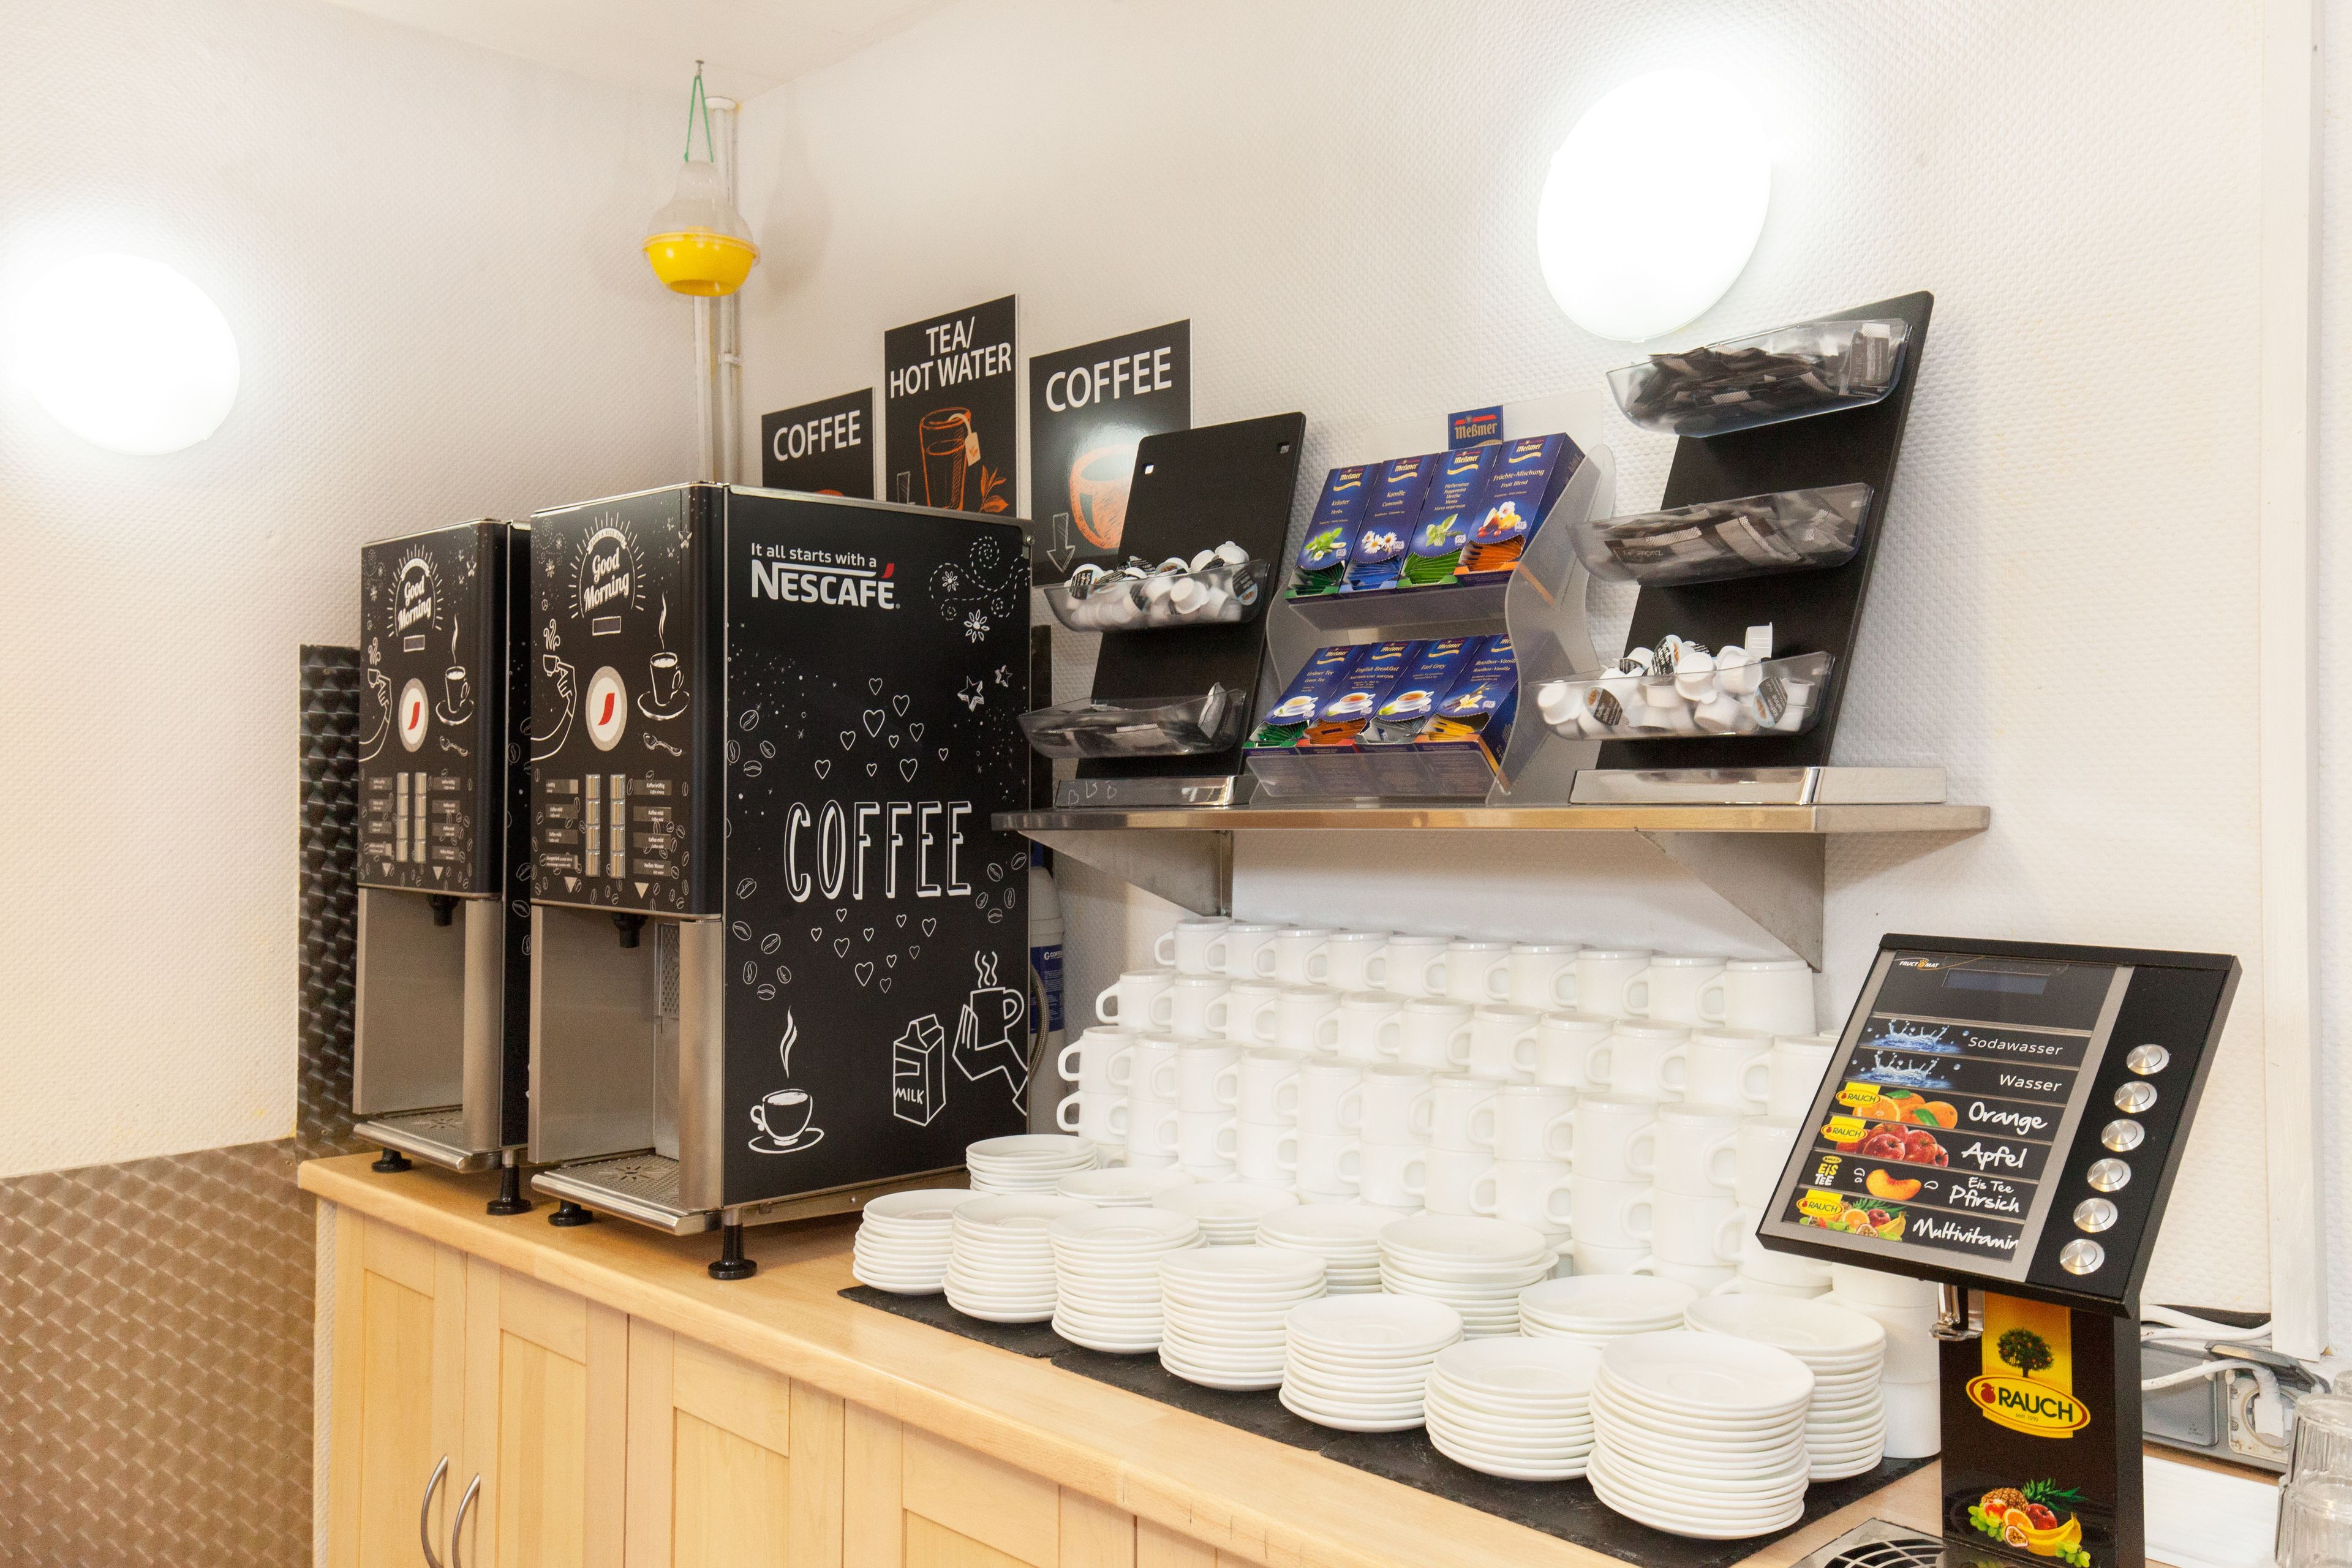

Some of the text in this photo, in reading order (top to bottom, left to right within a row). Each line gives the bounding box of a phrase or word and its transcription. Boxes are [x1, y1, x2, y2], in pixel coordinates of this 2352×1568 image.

[925, 316, 975, 356] TEA/
[890, 342, 1012, 399] HOT WATER
[1045, 347, 1172, 412] COFFEE
[773, 410, 861, 461] COFFEE
[1454, 422, 1498, 440] Meßmer
[1493, 469, 1545, 481] Früchte-Mischung
[592, 547, 620, 584] Good
[752, 543, 876, 568] It all starts with a
[404, 575, 424, 608] Good
[584, 573, 629, 612] Morning
[398, 597, 432, 632] Morning
[784, 799, 971, 903] COFFEE
[1968, 1036, 2064, 1055] Sodawasser
[895, 1087, 924, 1104] MILK
[1999, 1074, 2062, 1092] Wasser
[1847, 1093, 1877, 1103] RAUCH
[1832, 1127, 1862, 1137] RAUCH
[1969, 1101, 2048, 1136] Orange
[1961, 1142, 2027, 1170] Apfel
[1949, 1185, 2019, 1213] Pfirsich
[1968, 1177, 2014, 1193] Eis Tee
[1808, 1201, 1839, 1213] RAUCH
[1999, 1387, 2073, 1422] RAUCH
